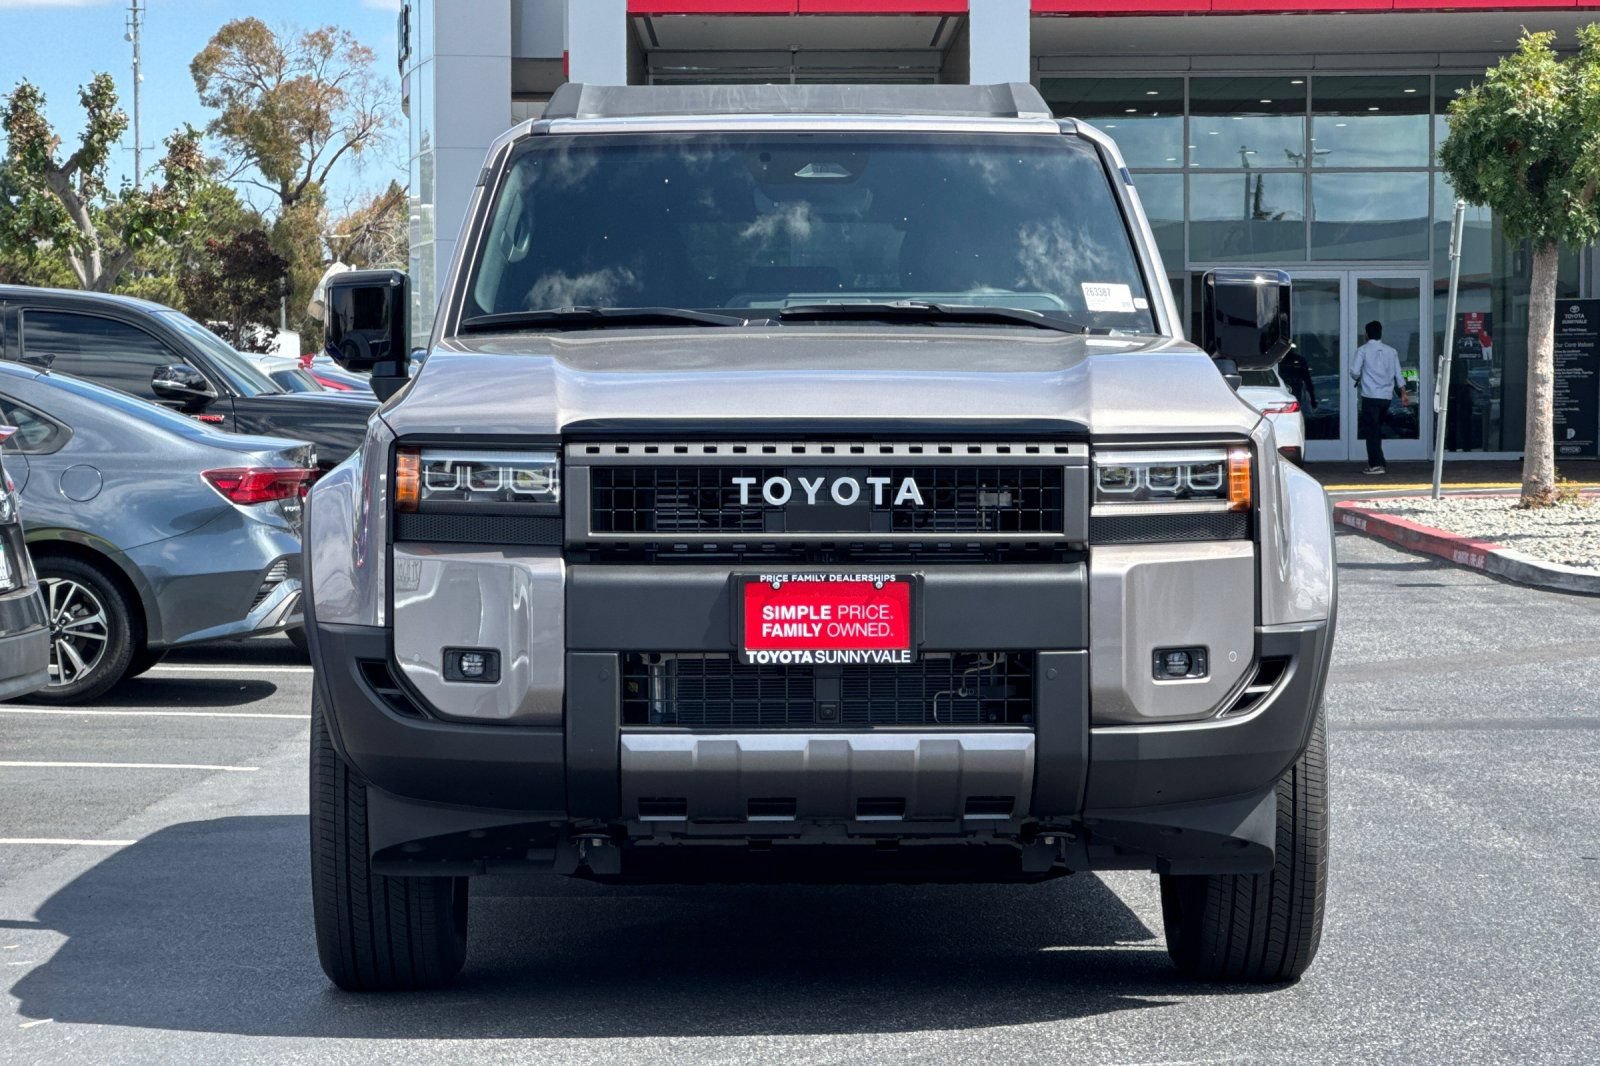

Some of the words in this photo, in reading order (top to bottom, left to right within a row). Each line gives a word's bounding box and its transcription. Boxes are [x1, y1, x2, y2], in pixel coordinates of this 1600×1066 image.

[732, 476, 924, 506] TOYOTA
[760, 574, 789, 582] PRICE
[791, 574, 826, 582] FAMILY
[829, 574, 896, 582] DEALERSHIPS
[762, 605, 831, 620] SIMPLE
[837, 605, 894, 620] PRICE.
[762, 623, 823, 637] FAMILY
[826, 622, 894, 637] OWNED.
[745, 651, 814, 664] TOYOTA
[814, 650, 911, 664] SUNNYVALE
